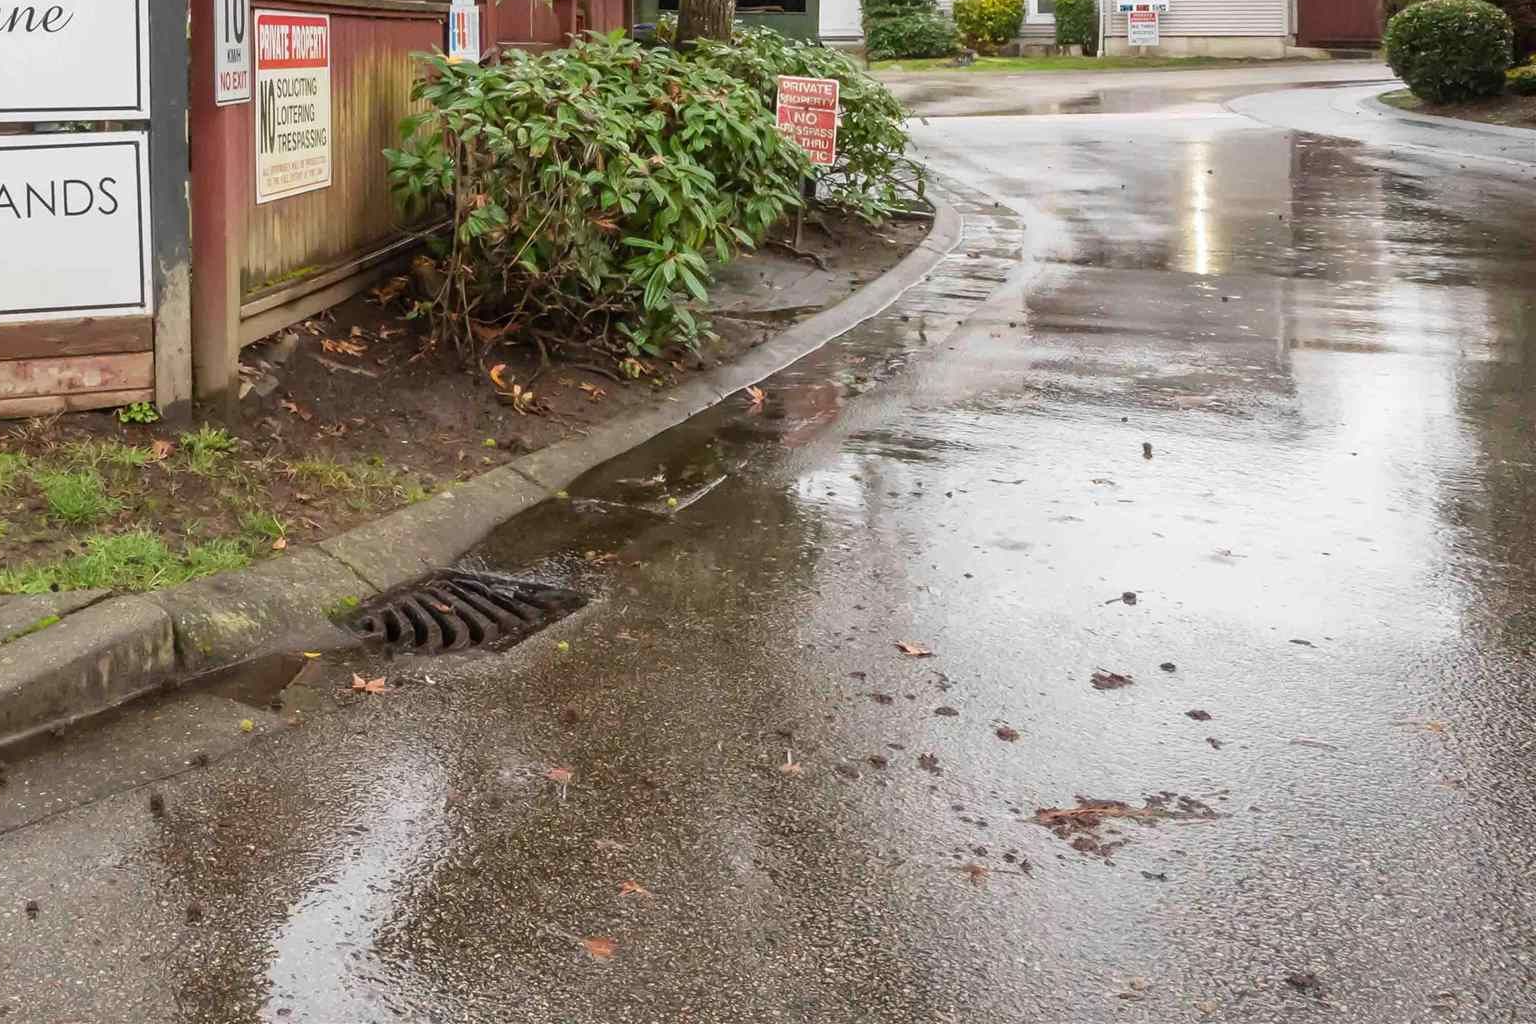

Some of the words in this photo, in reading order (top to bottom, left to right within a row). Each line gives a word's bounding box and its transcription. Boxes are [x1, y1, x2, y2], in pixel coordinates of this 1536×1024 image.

[259, 23, 290, 62] PRIVATE
[291, 24, 328, 60] PROPERTY
[220, 72, 232, 92] NO
[233, 71, 248, 90] EXIT
[783, 81, 833, 95] PRIVATE
[260, 79, 275, 154] NO
[277, 78, 318, 98] SOLICITING
[277, 103, 315, 126] LOITERING
[794, 111, 817, 125] NO
[277, 128, 327, 153] TRESPASSING
[801, 137, 829, 150] THRU
